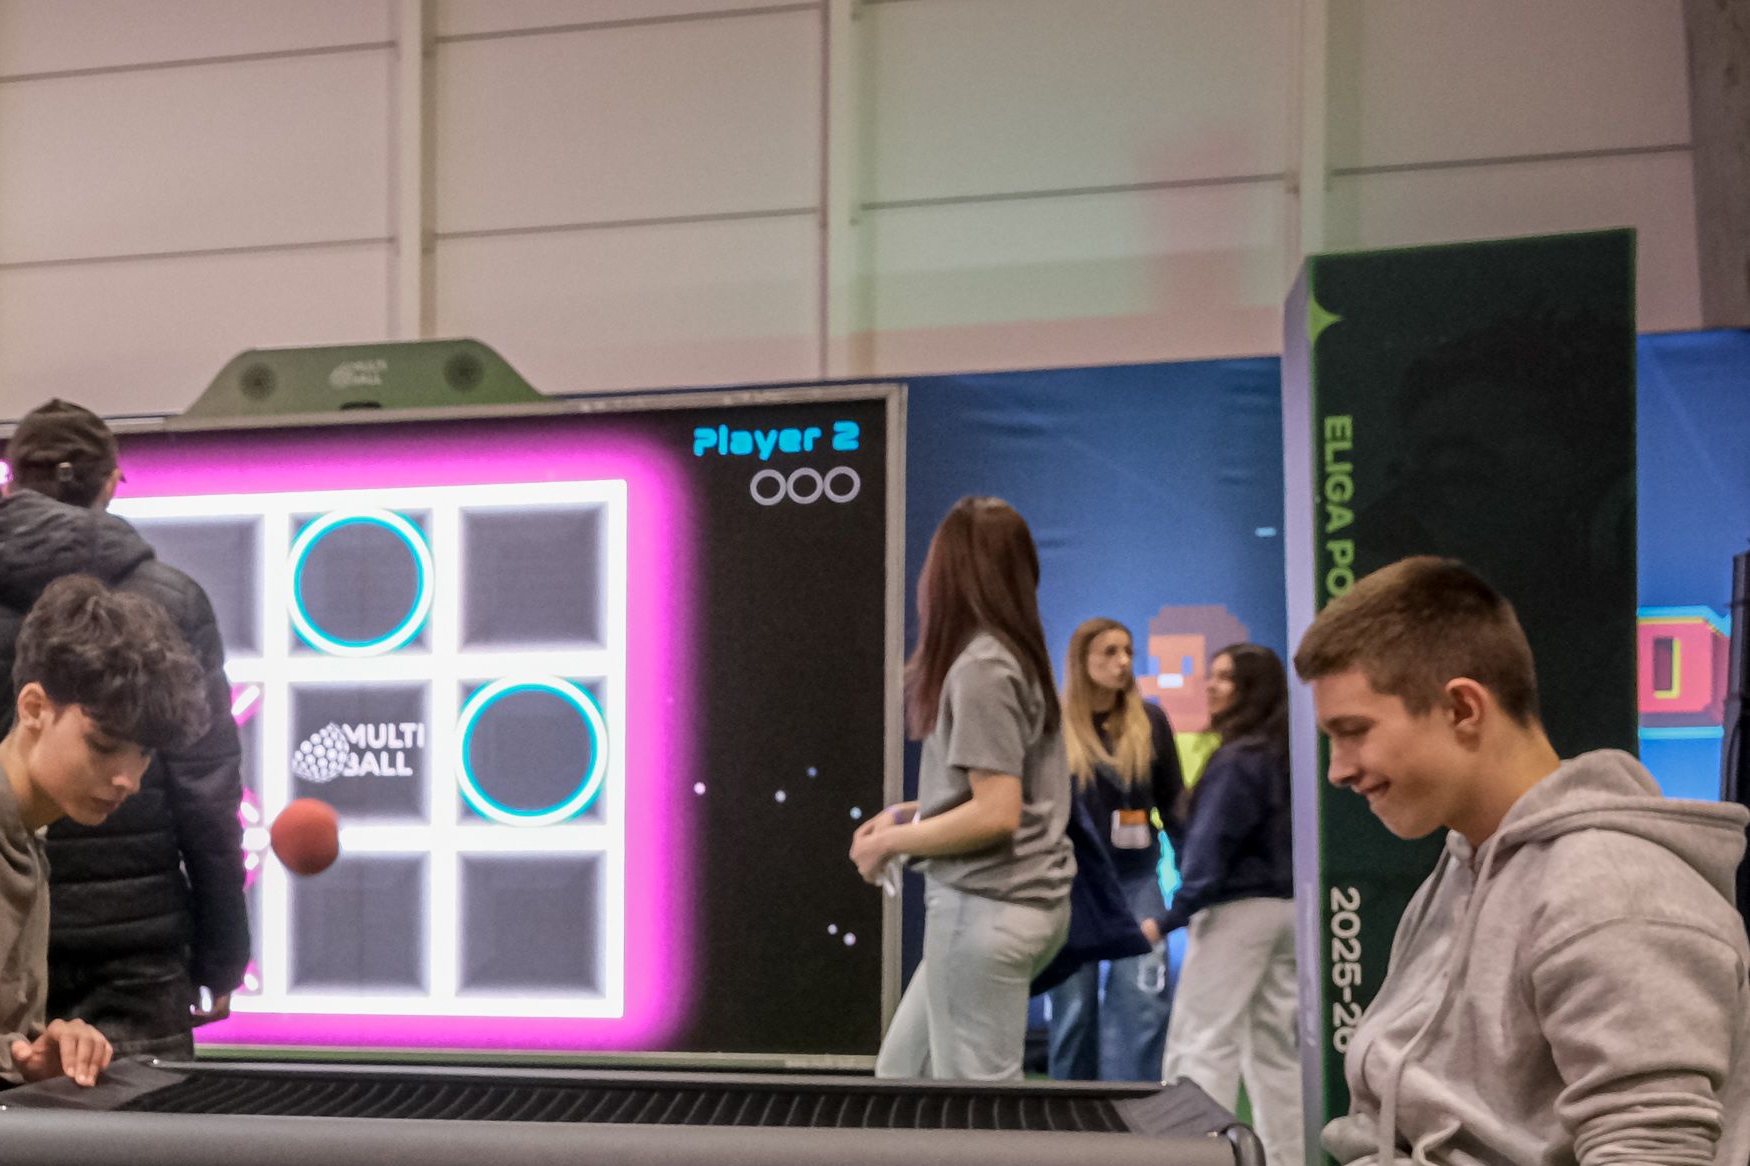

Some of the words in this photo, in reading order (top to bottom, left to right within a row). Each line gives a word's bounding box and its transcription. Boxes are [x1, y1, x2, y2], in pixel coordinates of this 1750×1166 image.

[693, 424, 822, 461] Player
[832, 420, 860, 451] 2
[1324, 415, 1354, 534] ELIGA
[342, 722, 425, 749] MULTI
[1330, 886, 1362, 1054] 2025-26
